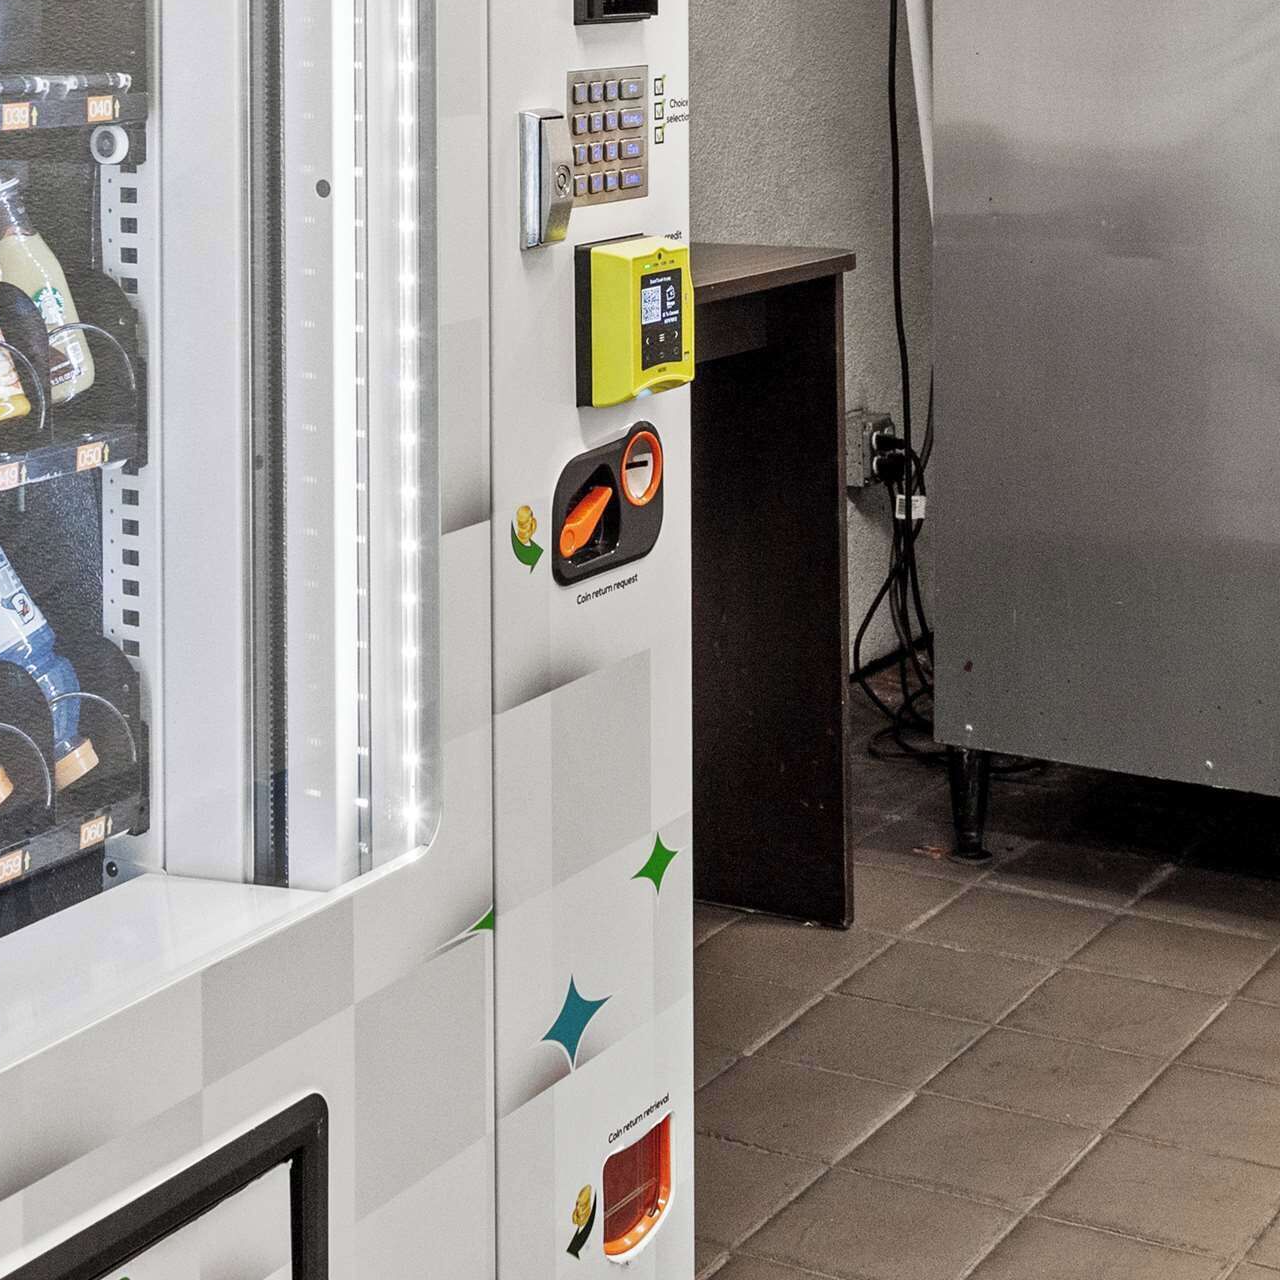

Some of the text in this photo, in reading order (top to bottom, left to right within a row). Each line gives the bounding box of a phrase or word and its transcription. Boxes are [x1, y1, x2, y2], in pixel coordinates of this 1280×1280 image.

[3, 106, 30, 127] 039
[89, 98, 113, 118] 040
[78, 446, 102, 467] 050
[576, 572, 639, 605] Coin return request
[82, 820, 105, 844] 060
[608, 1092, 670, 1144] Coin return retrieval
